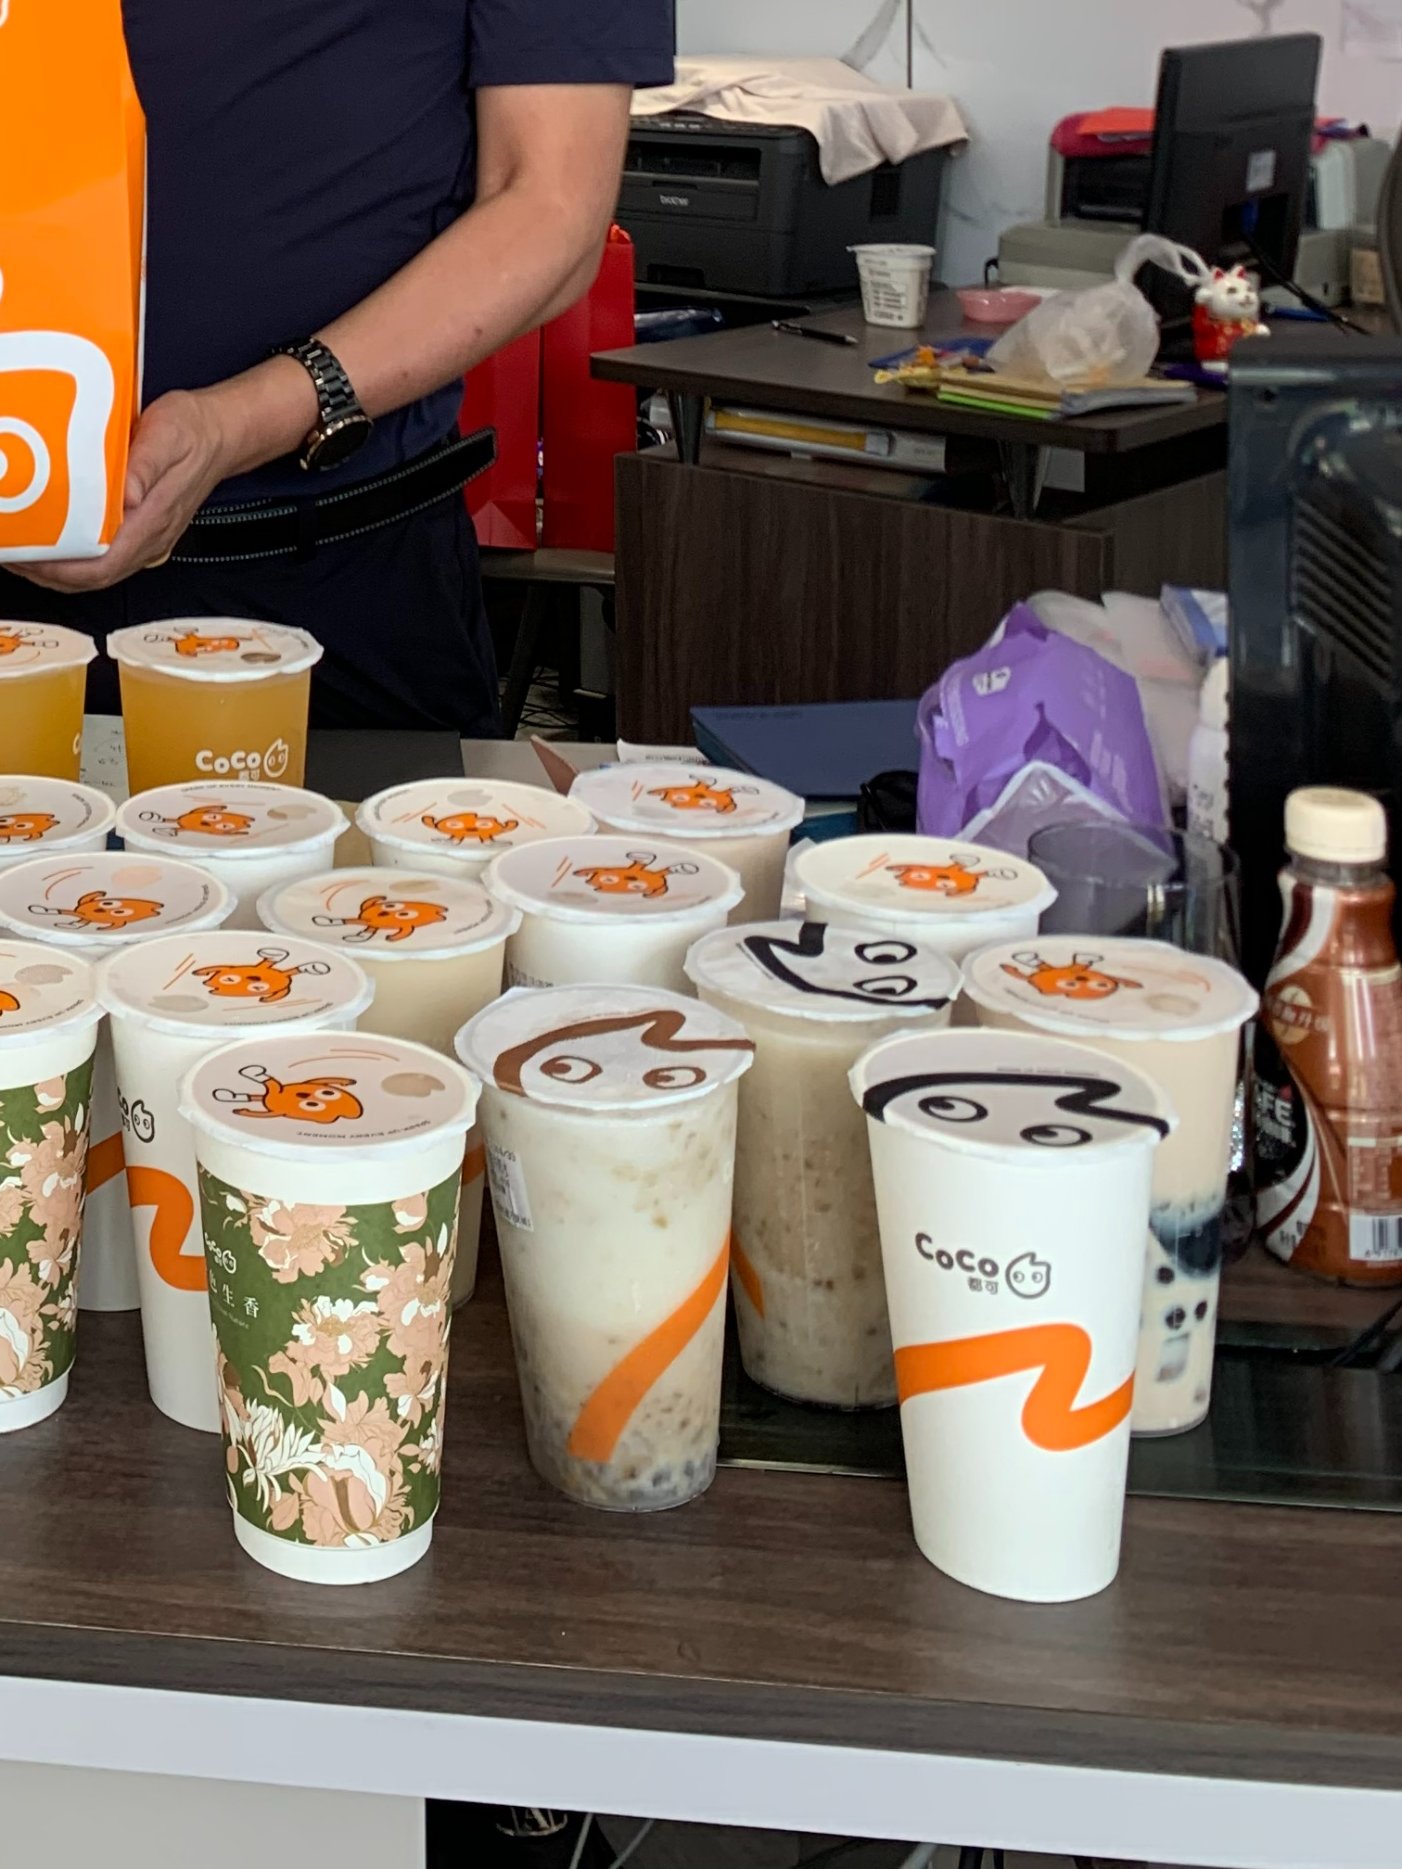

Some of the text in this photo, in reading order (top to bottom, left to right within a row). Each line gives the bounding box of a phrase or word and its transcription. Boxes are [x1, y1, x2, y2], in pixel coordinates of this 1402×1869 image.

[195, 749, 262, 775] CoCo
[915, 1232, 1000, 1278] CoCo
[967, 1276, 999, 1295] 都可
